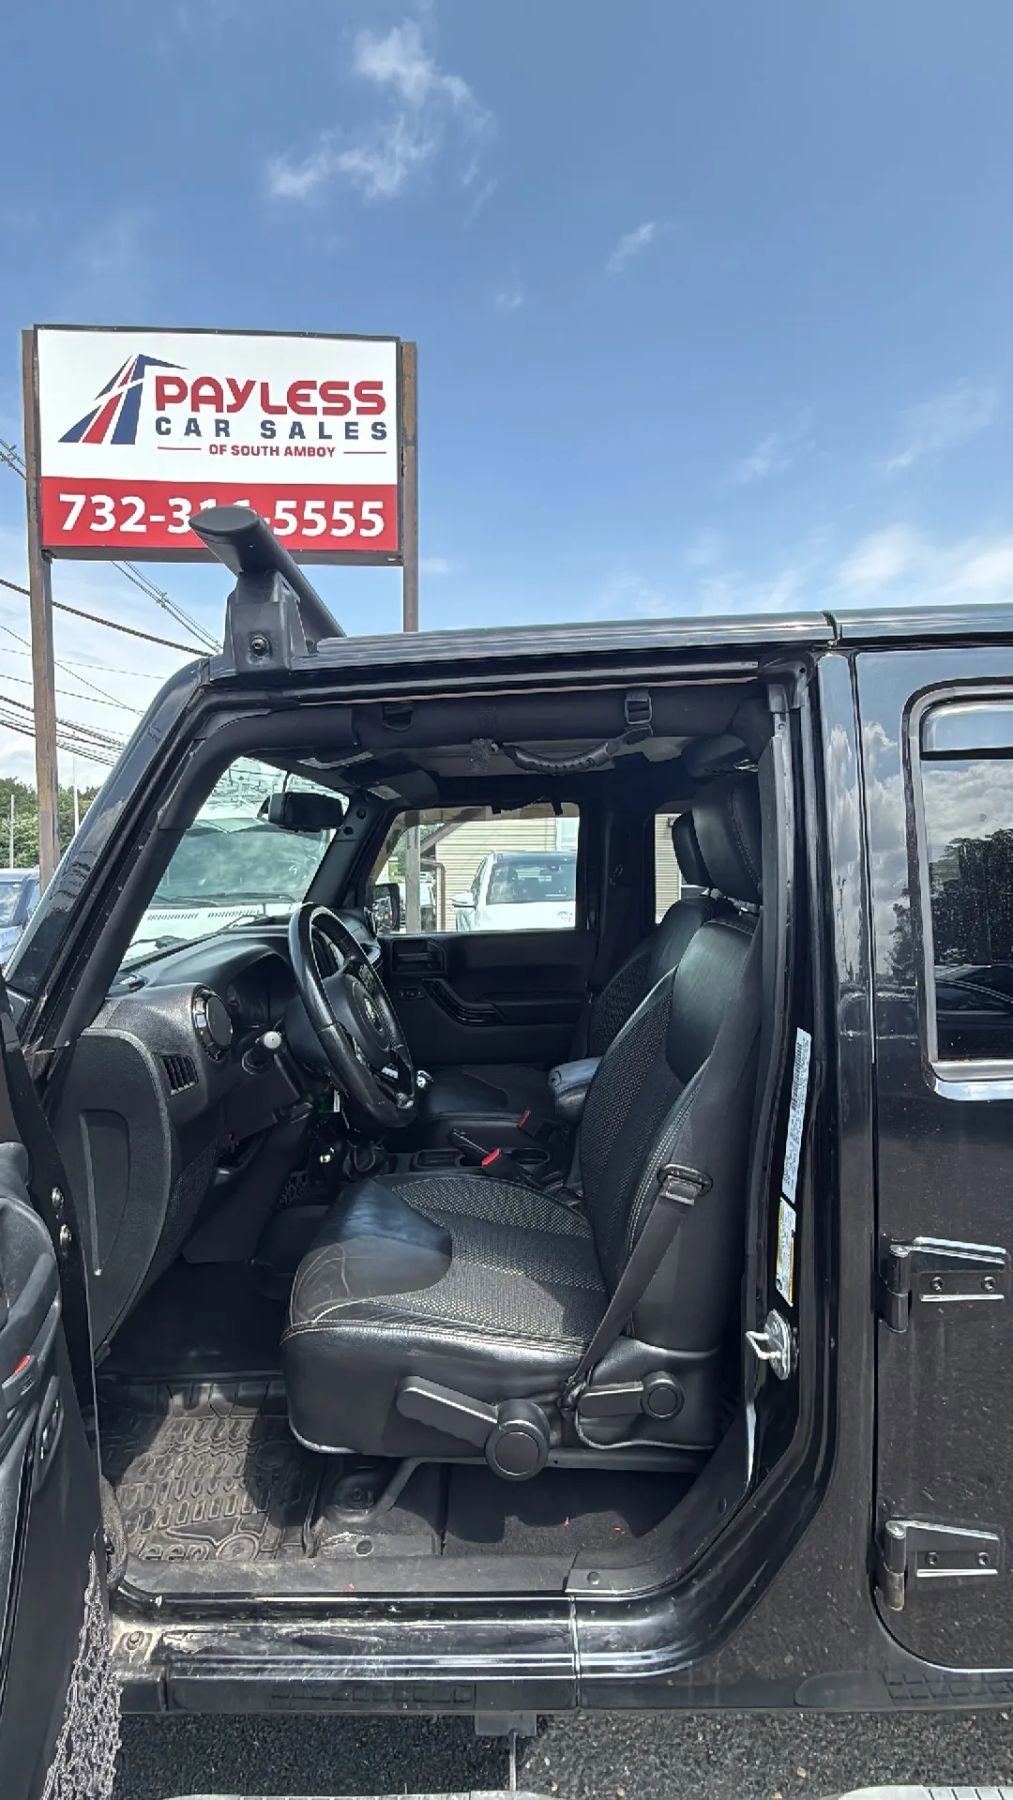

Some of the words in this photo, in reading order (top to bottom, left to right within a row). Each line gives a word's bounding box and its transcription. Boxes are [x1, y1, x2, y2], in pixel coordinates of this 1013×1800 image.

[155, 375, 386, 416] PAYLESS
[155, 416, 231, 438] CAR
[260, 419, 387, 441] SALES
[209, 444, 228, 456] OF
[231, 445, 280, 457] SOUTH
[284, 446, 336, 458] AMBOY
[58, 493, 385, 537] 732-35555
